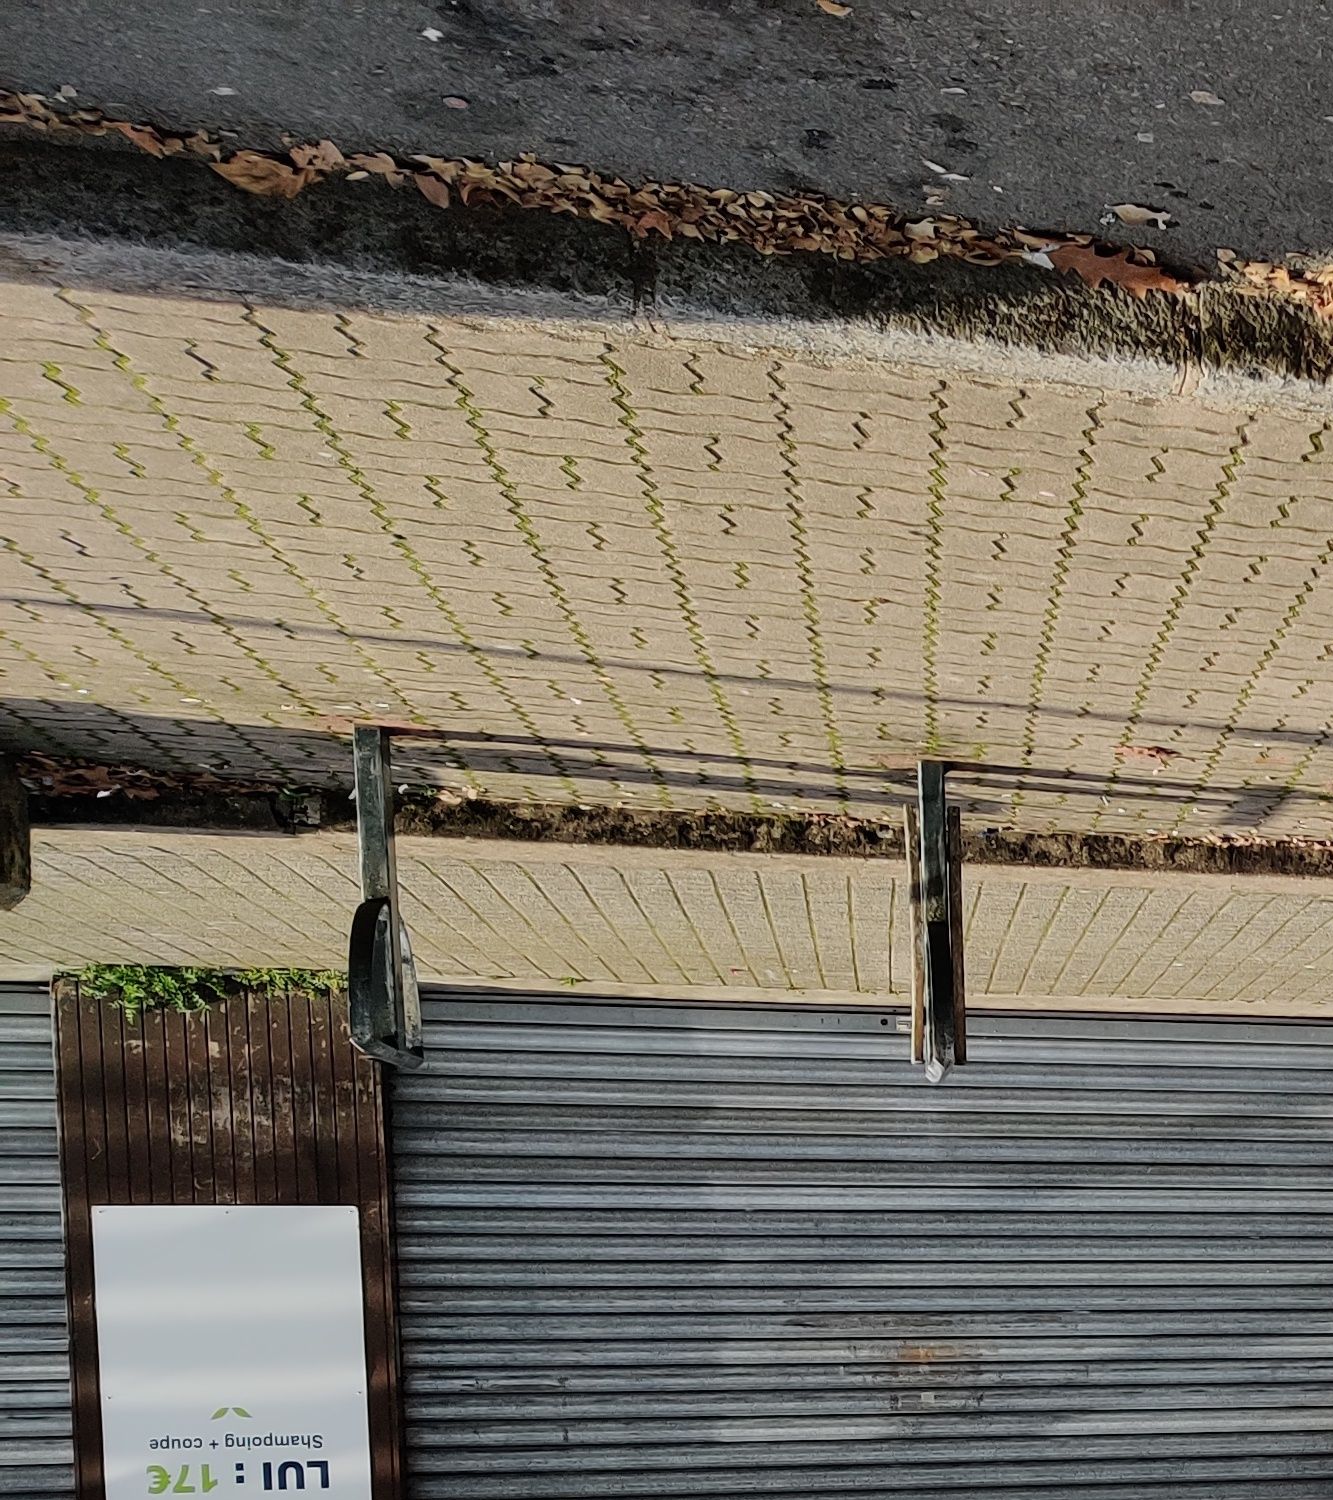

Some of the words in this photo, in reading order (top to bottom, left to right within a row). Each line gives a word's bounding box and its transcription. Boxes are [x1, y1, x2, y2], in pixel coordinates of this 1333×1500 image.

[149, 1435, 203, 1450] coupe
[225, 1433, 323, 1451] Shampoing
[146, 1463, 218, 1494] 17€
[263, 1460, 329, 1491] LUI
